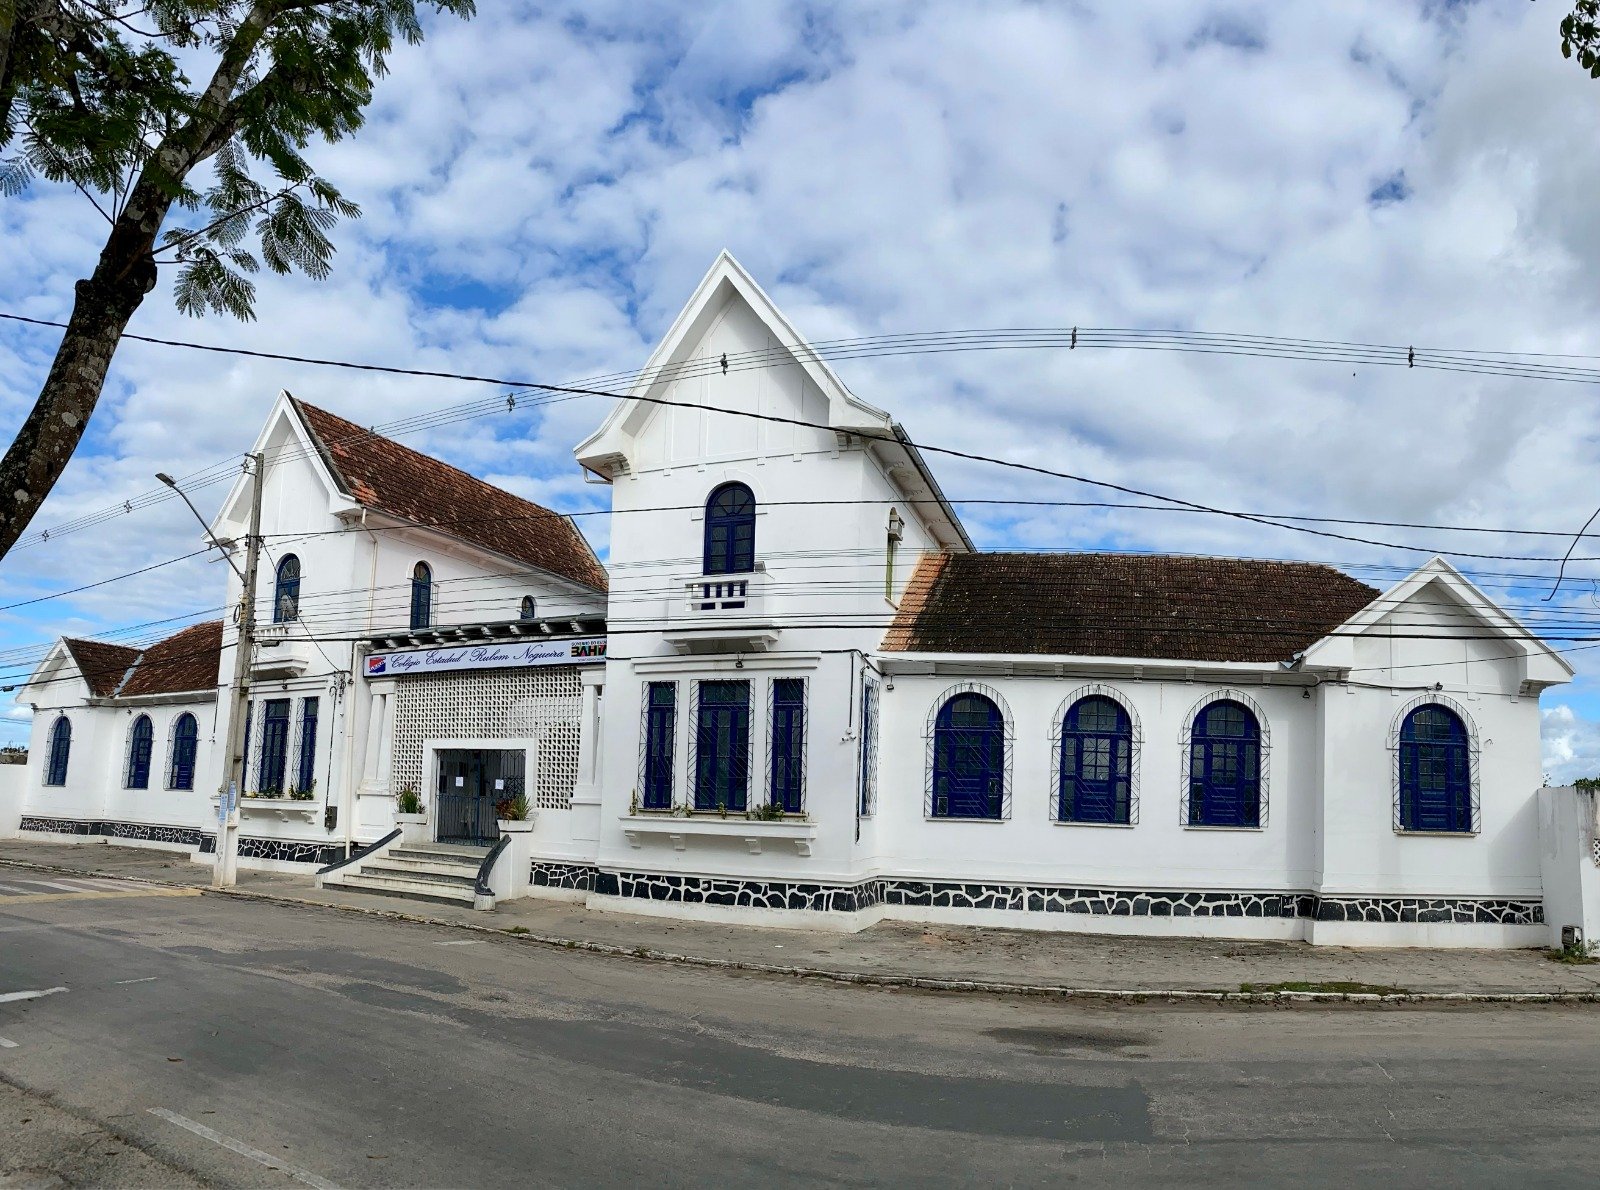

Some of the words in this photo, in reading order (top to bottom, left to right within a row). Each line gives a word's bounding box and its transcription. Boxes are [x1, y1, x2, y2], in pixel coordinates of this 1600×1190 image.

[390, 655, 421, 671] Colégio
[426, 651, 467, 665] Estadual
[469, 647, 509, 662] Rubem
[513, 644, 565, 663] Nogueira
